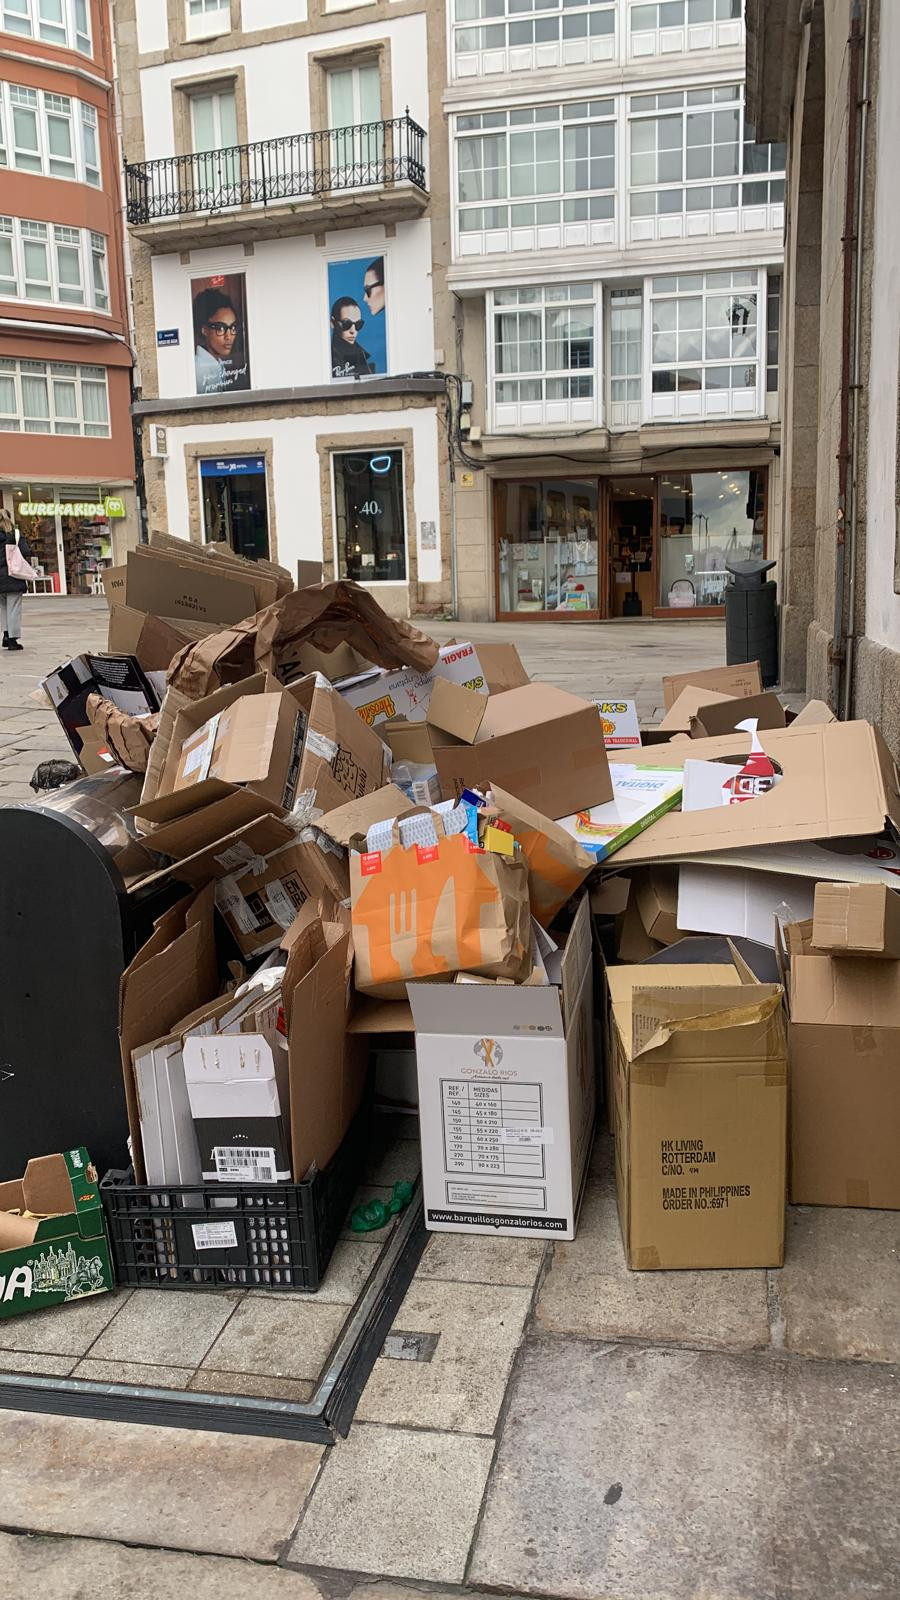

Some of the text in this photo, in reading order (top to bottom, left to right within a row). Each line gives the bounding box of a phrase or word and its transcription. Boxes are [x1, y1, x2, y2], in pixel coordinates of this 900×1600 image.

[441, 646, 474, 665] FRAGIL
[615, 780, 665, 789] DIGITAL
[460, 1067, 498, 1076] GONZALO
[661, 1140, 703, 1151] HK LIVING
[661, 1151, 716, 1164] ROTTERDAM
[661, 1164, 685, 1176] C/NO.
[662, 1185, 751, 1199] MADE IN PHILIPPINES
[662, 1198, 693, 1210] ORDER
[431, 1212, 563, 1229] www.barquillosgonzalorios.com
